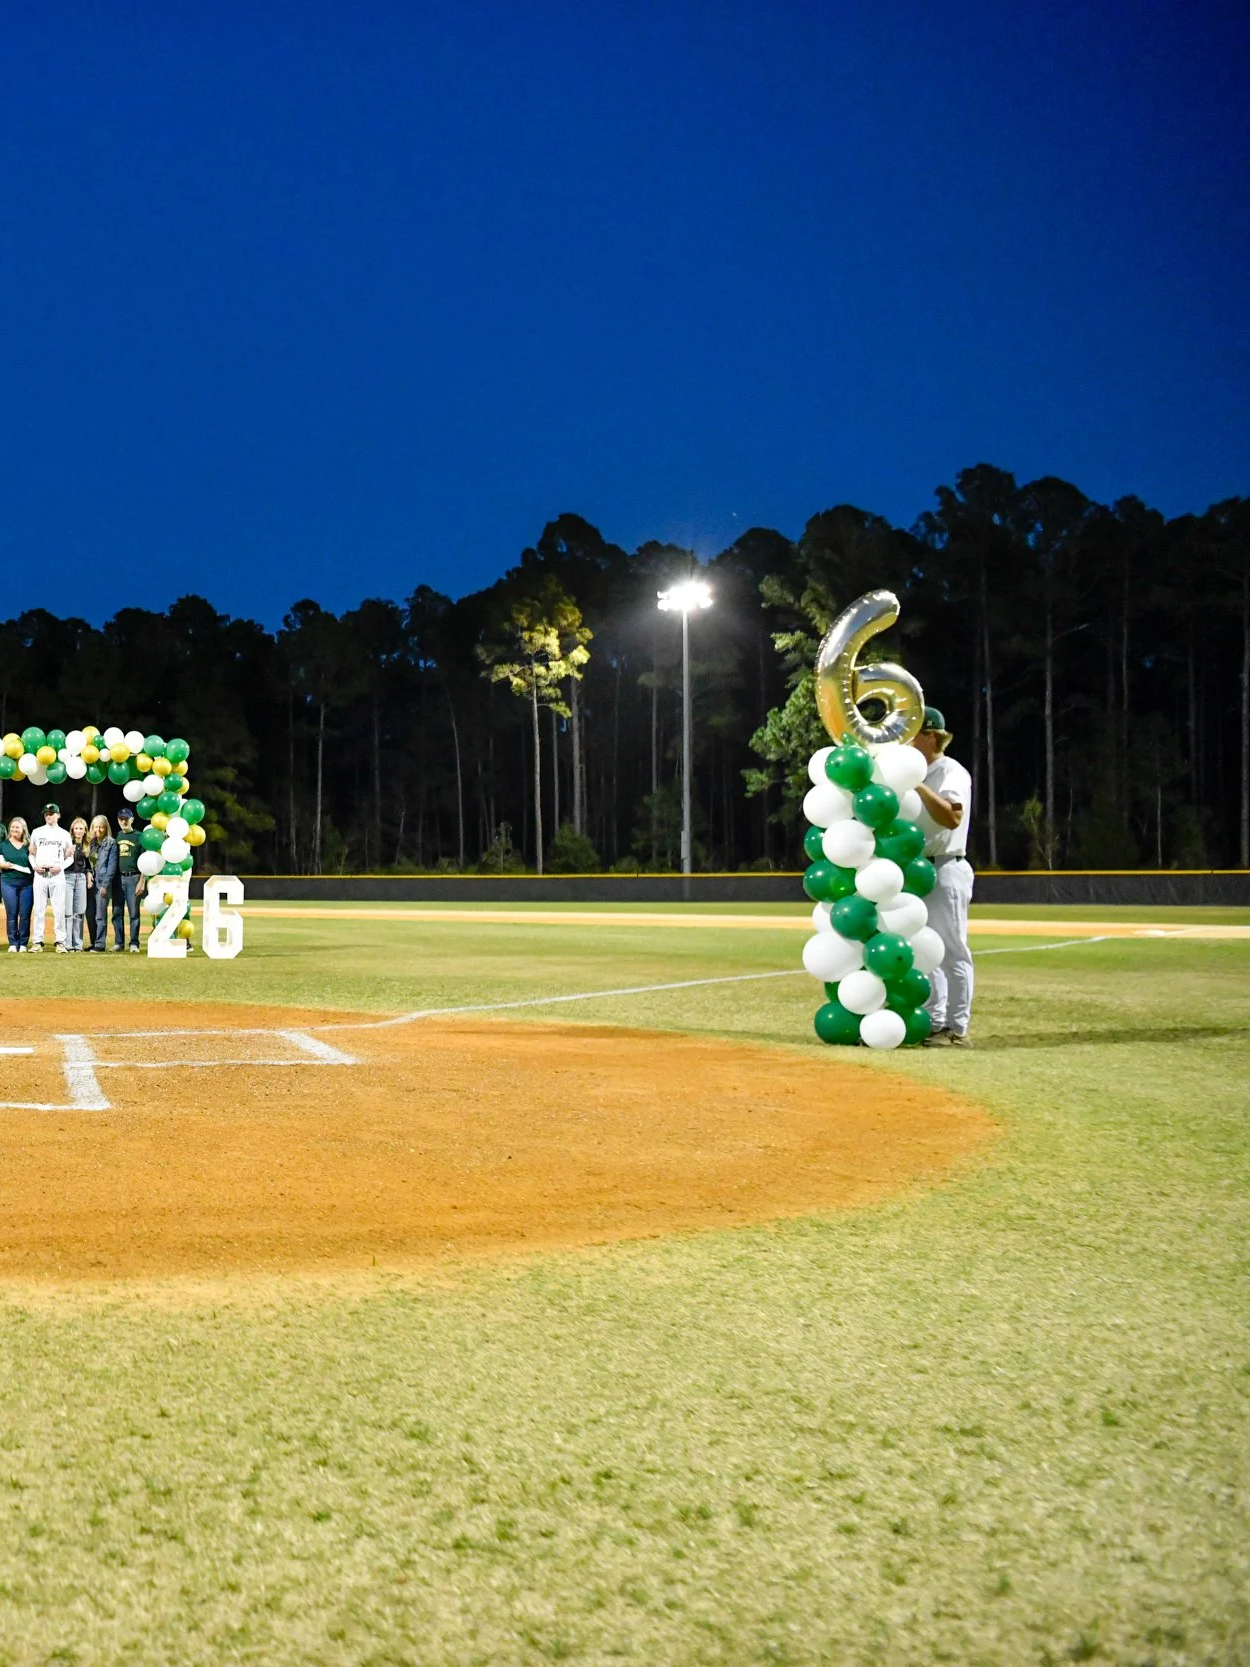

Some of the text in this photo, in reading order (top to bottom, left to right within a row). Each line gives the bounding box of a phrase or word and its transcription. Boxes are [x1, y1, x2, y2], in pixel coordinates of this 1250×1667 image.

[815, 589, 925, 746] 6
[38, 838, 62, 848] Fleming
[147, 875, 244, 959] 26
